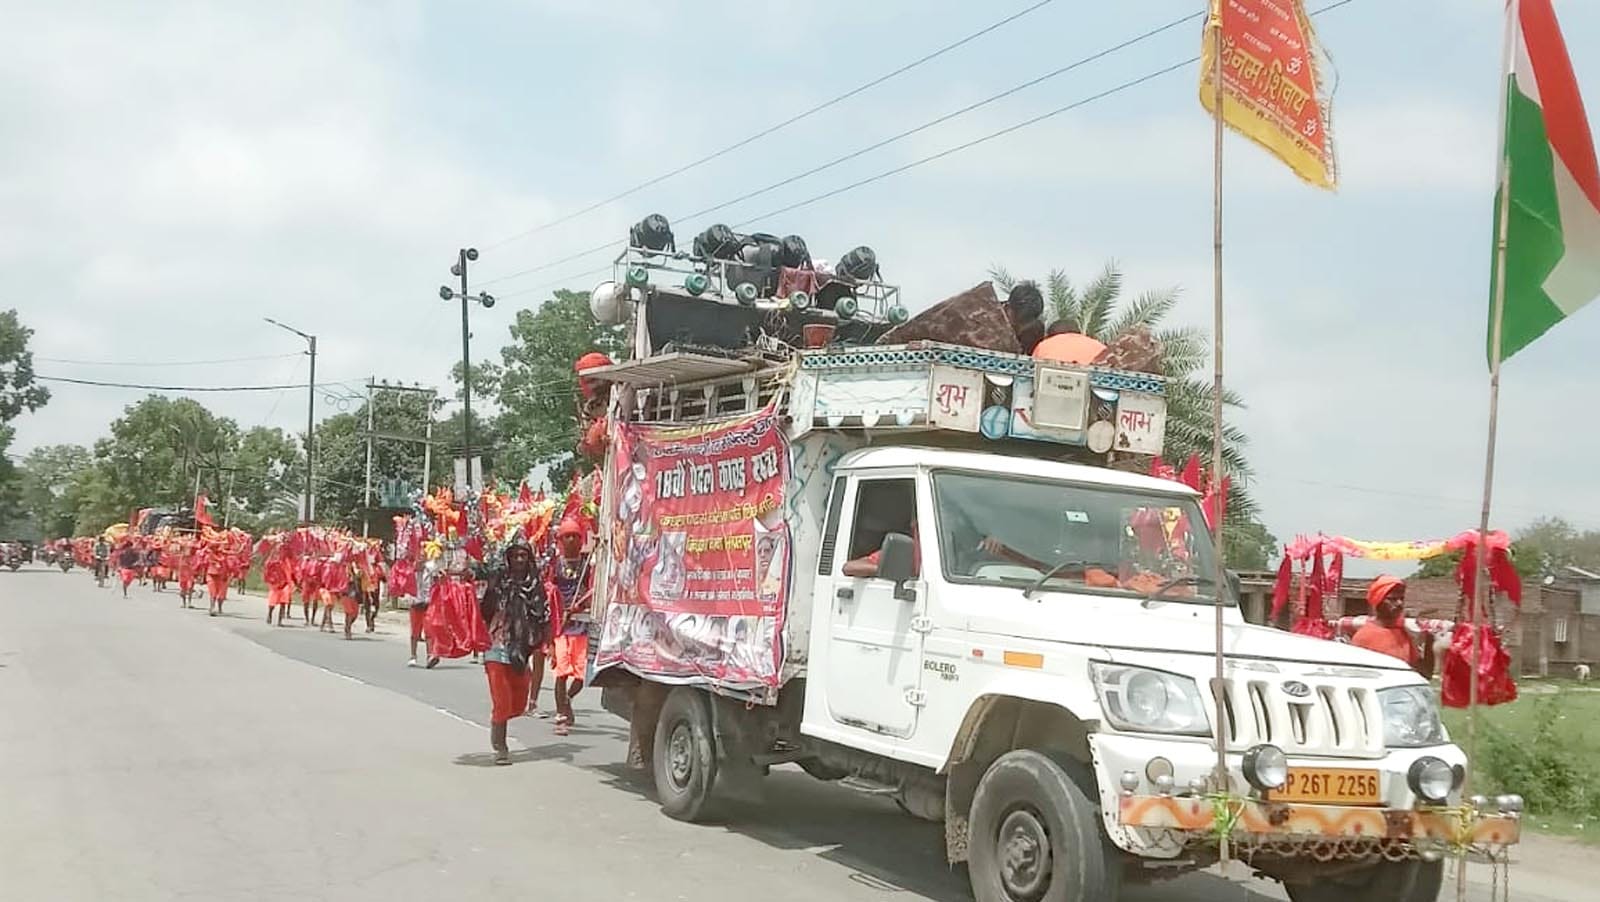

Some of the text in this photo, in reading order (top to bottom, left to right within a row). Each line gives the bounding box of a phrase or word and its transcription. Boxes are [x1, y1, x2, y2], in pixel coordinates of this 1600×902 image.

[1264, 58, 1311, 116] शिवाय
[936, 384, 970, 414] शुभ
[1120, 409, 1153, 432] लाभ
[923, 659, 957, 674] BOLERO
[1301, 773, 1332, 796] 26T
[1337, 775, 1377, 797] 2256
